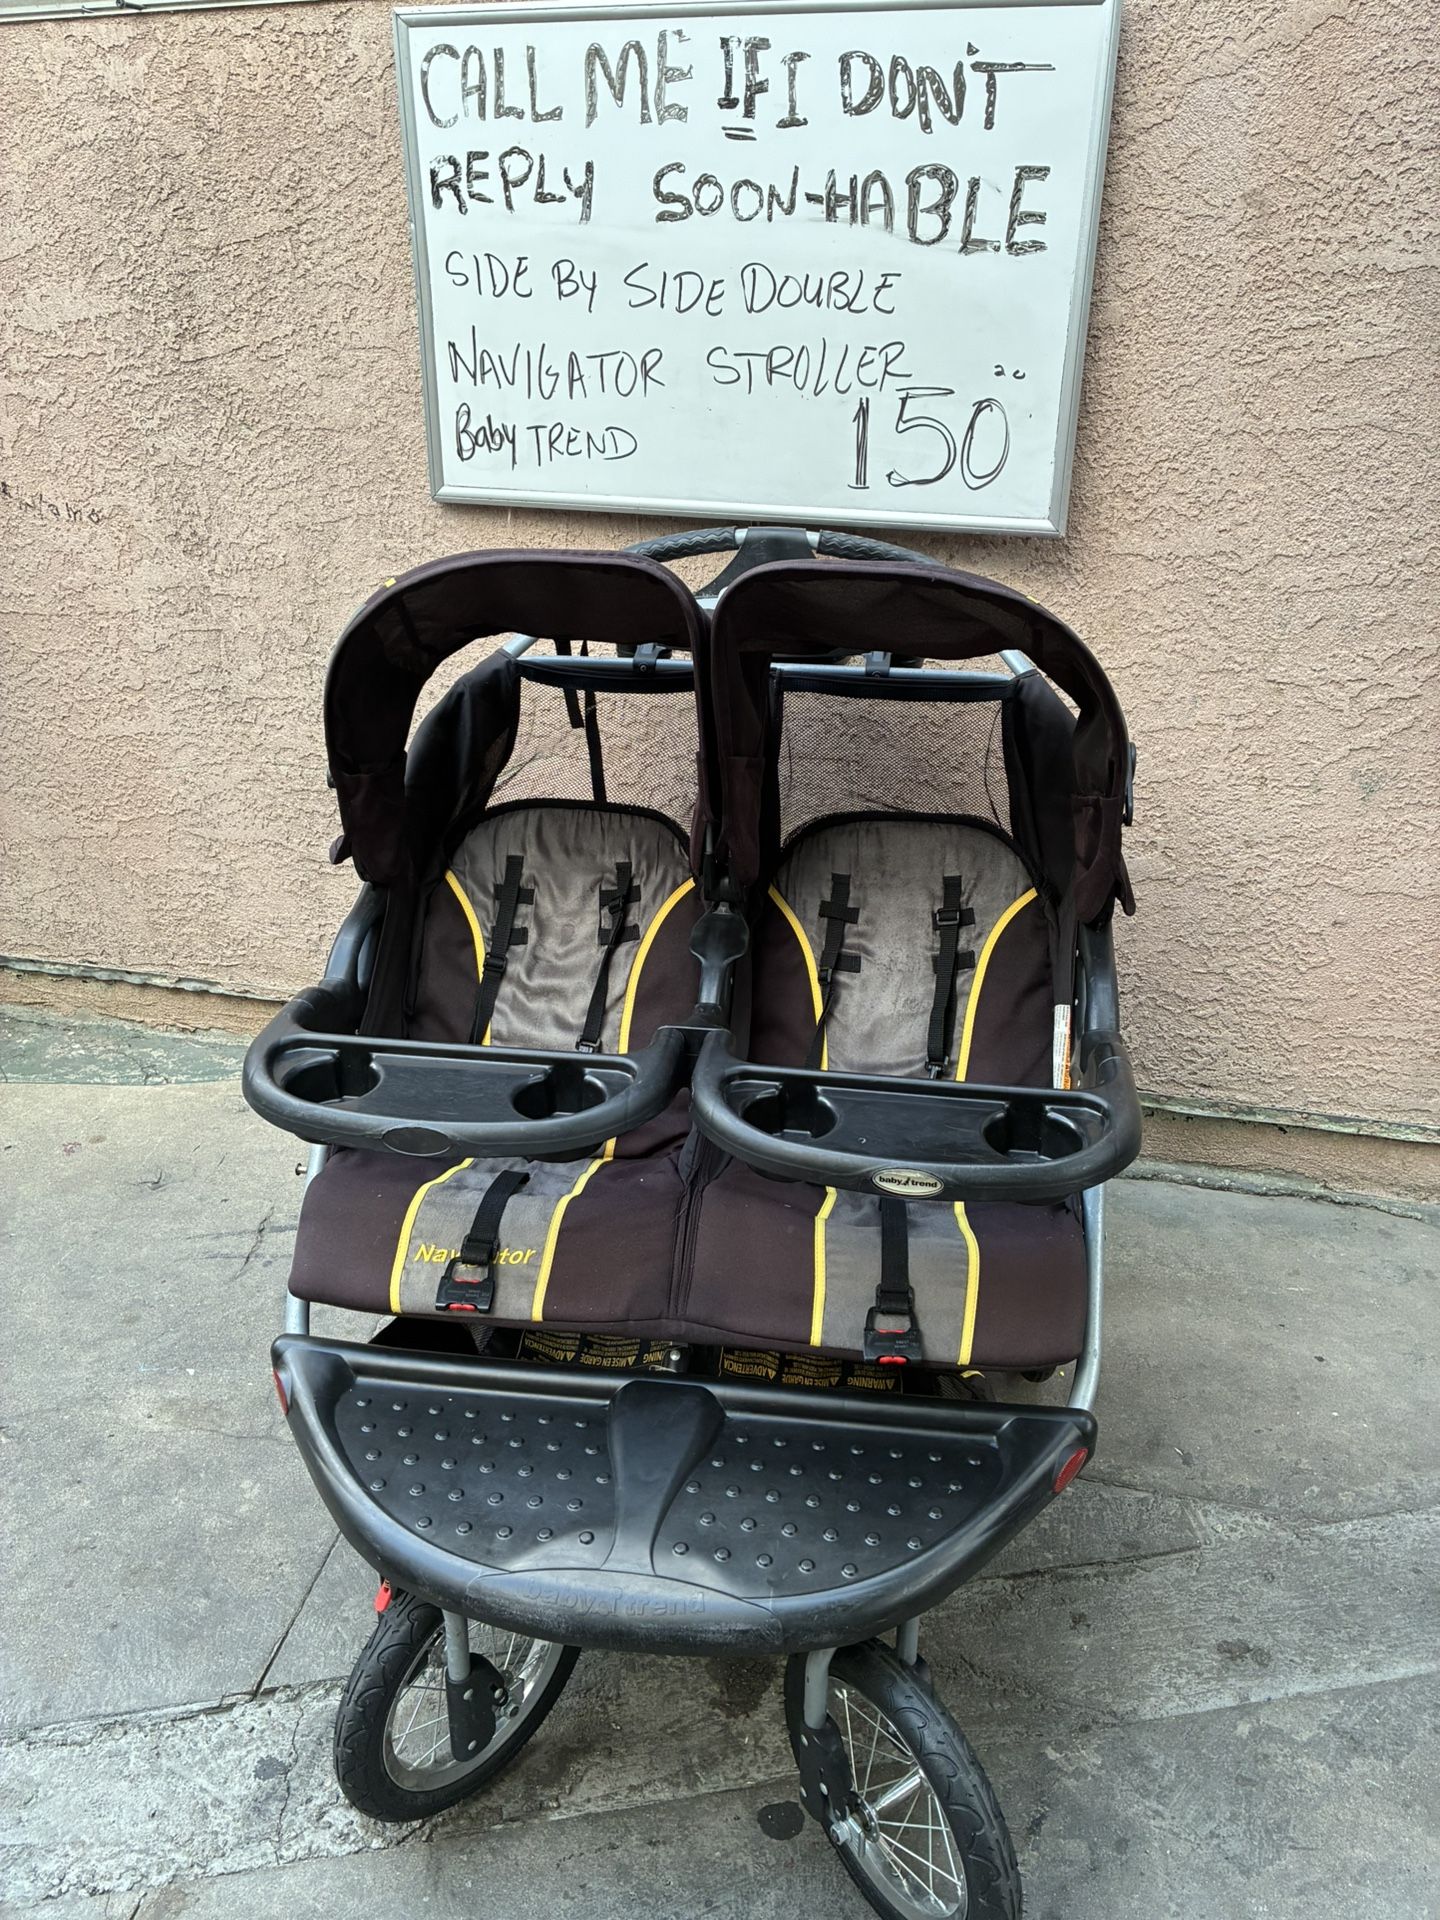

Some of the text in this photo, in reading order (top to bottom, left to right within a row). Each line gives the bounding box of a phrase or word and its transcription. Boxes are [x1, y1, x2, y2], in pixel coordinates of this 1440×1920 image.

[420, 29, 1057, 134] CALL ME IF I DON'T
[429, 145, 595, 225] REPLY
[445, 250, 533, 298] SIDE
[623, 262, 725, 317] SIDE
[740, 262, 903, 314] DOUBLE
[447, 324, 914, 400] NAVIGATOR STROLLER
[455, 402, 639, 471] Baby TREND
[847, 386, 1012, 491] 150
[878, 1175, 939, 1189] baby trend
[413, 1243, 537, 1268] Navtor
[723, 1358, 768, 1377] ADVERTENCIA
[847, 1376, 886, 1390] WARNING
[626, 1592, 707, 1617] trend
